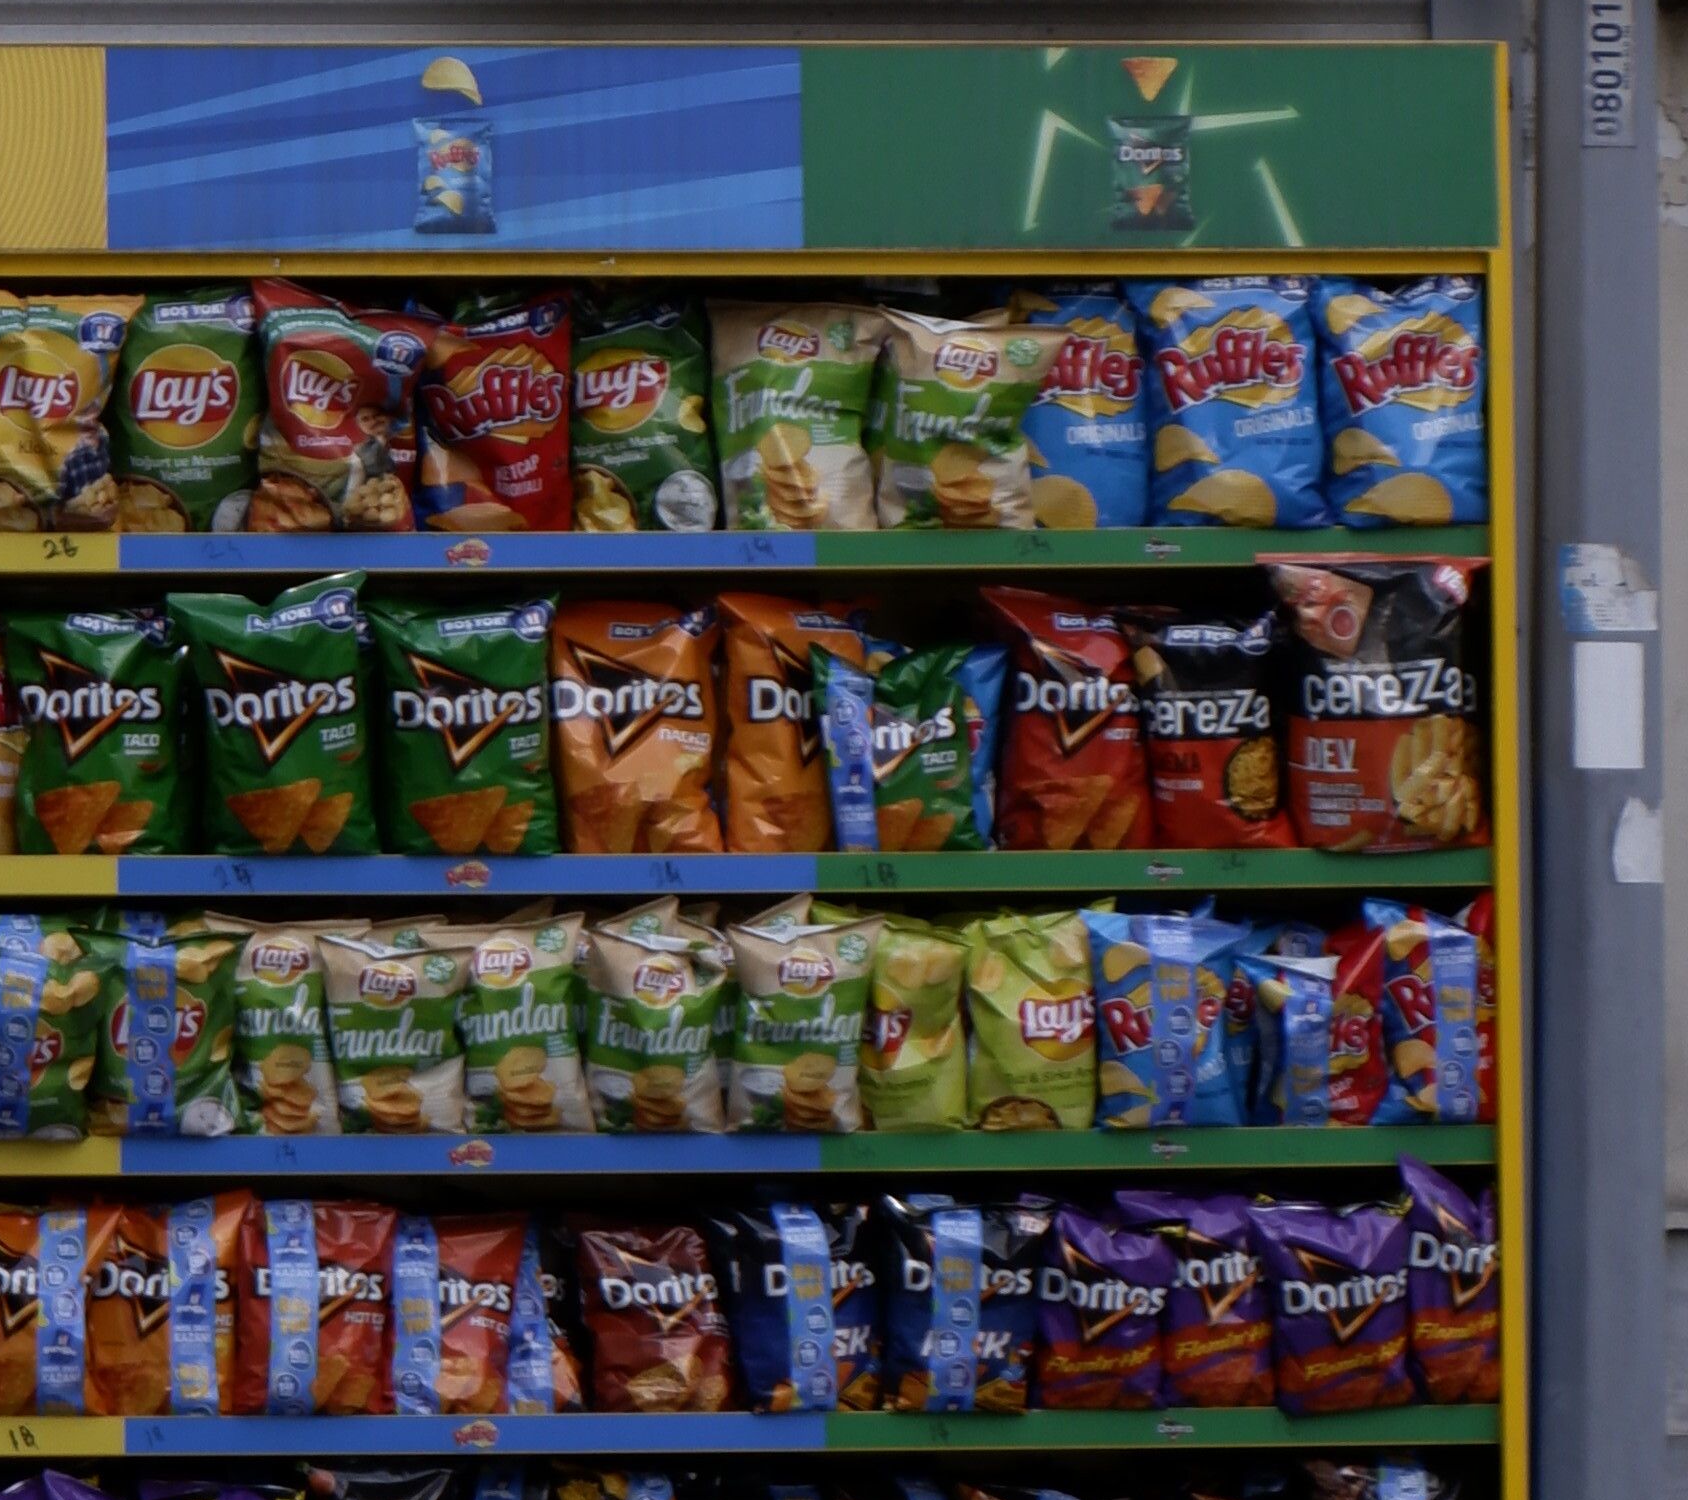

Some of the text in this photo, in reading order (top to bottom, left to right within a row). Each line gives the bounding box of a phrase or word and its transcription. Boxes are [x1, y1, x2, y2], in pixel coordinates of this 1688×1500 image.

[760, 326, 819, 358] Lay's
[937, 344, 998, 381] Lay's
[0, 366, 76, 419] Lay's
[286, 360, 358, 412] Lay's
[575, 354, 668, 410] Lay's
[1155, 326, 1308, 414] Ruffles
[1330, 330, 1480, 416] Ruffles
[135, 367, 235, 426] Lay's
[423, 362, 565, 442] Ruffles
[19, 681, 162, 723] Doritos
[207, 675, 358, 727] Doritos
[393, 683, 543, 732] Doritos
[551, 678, 704, 719] Doritos
[1303, 735, 1358, 772] DEV
[1022, 997, 1095, 1045] Lay's
[1039, 1268, 1167, 1316] Doritos
[1282, 1268, 1409, 1315] Doritos
